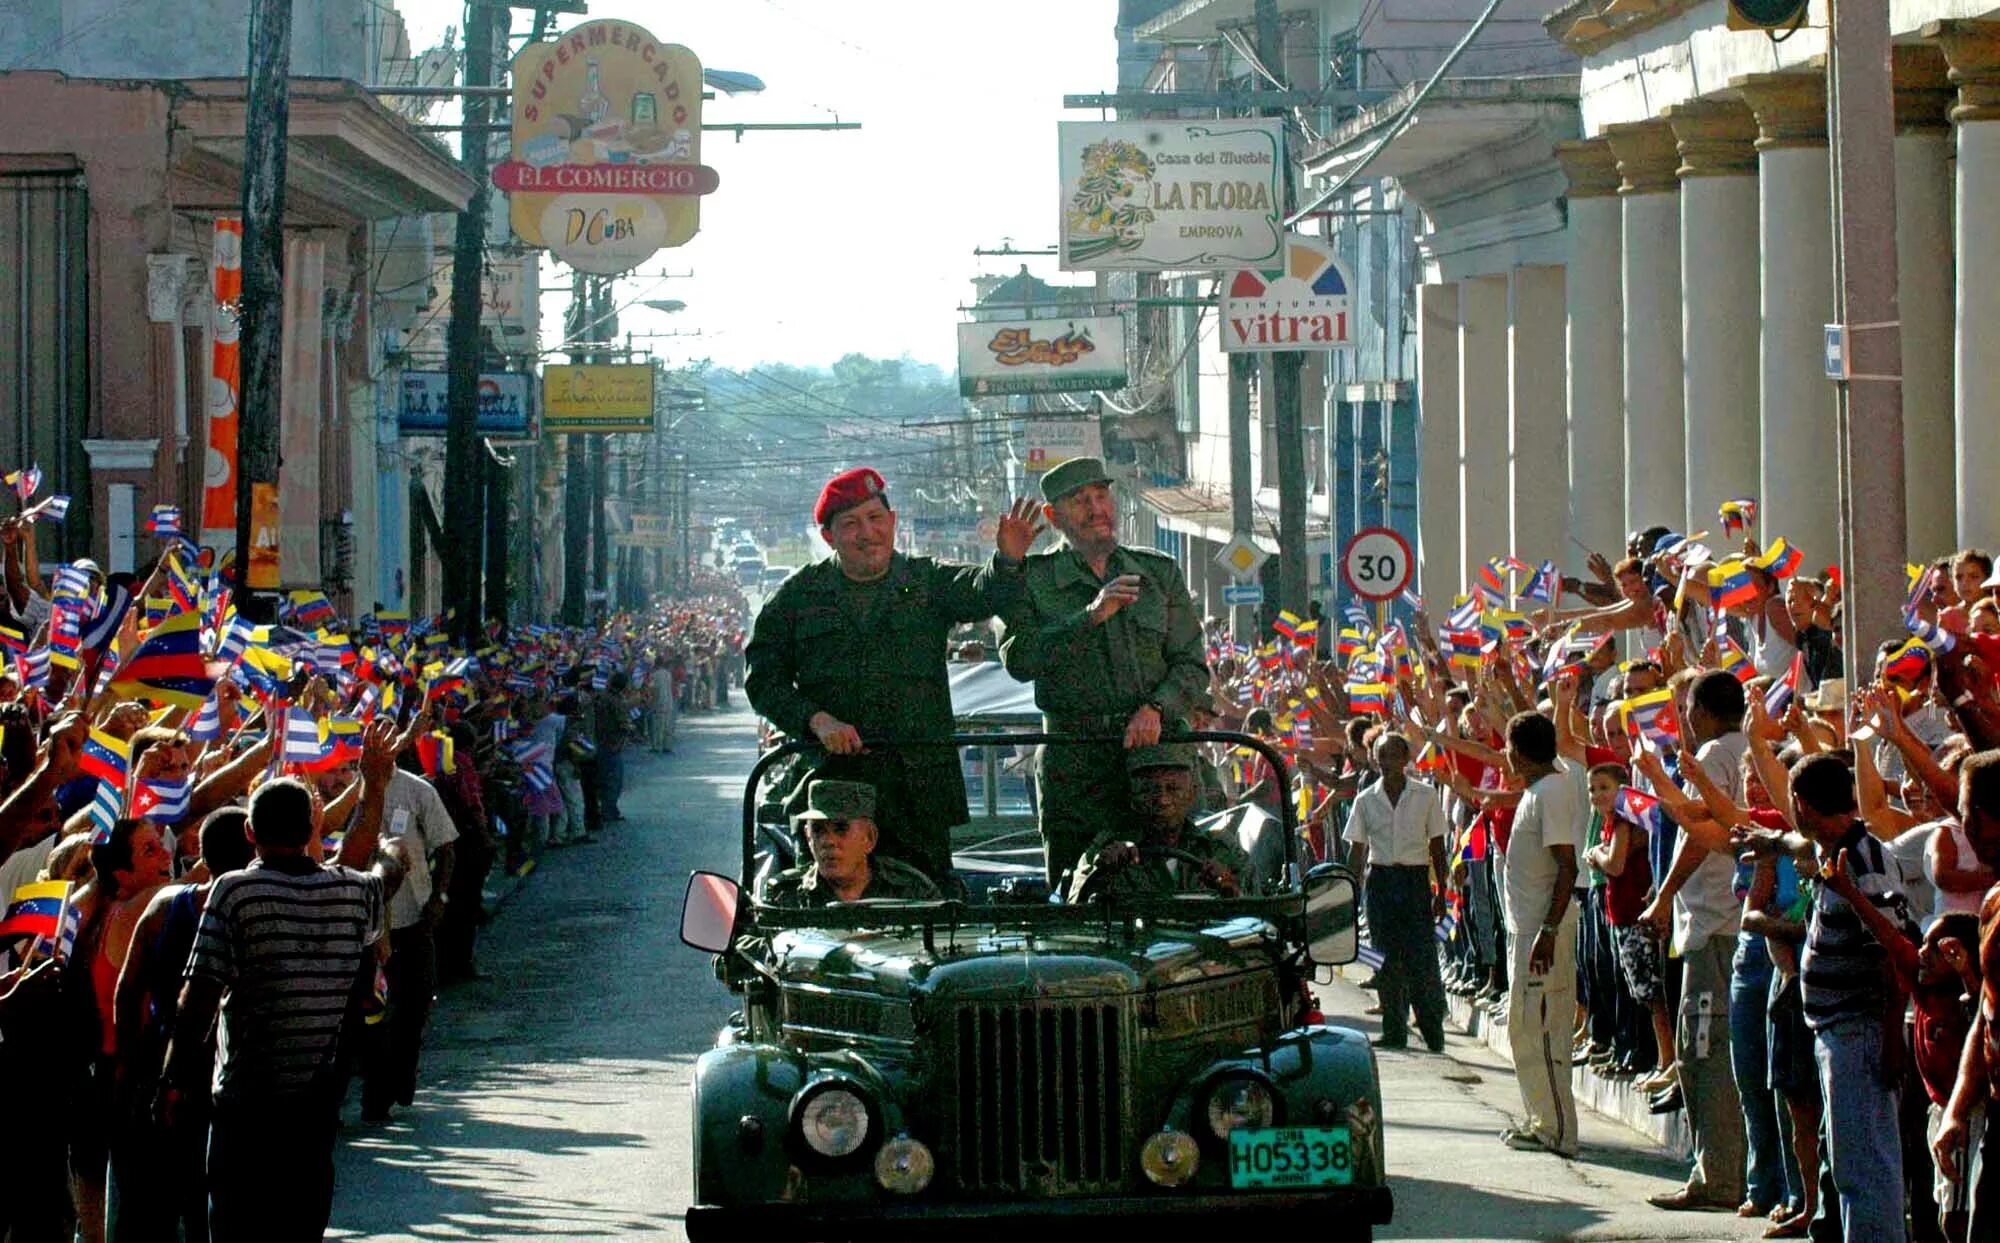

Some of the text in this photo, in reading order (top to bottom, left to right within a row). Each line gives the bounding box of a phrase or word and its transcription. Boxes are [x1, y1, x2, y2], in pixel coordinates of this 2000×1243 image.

[524, 25, 688, 123] SUPERMERCADO
[1156, 152, 1190, 165] Casa
[1194, 151, 1215, 165] del
[518, 166, 694, 189] EL COMERCIO
[1154, 181, 1270, 210] LA FLORA
[1179, 225, 1243, 238] EMPROVA
[1230, 299, 1347, 310] PINTURAS
[1230, 311, 1347, 344] vitral
[1358, 555, 1396, 581] 30
[1232, 1141, 1350, 1173] H05338
